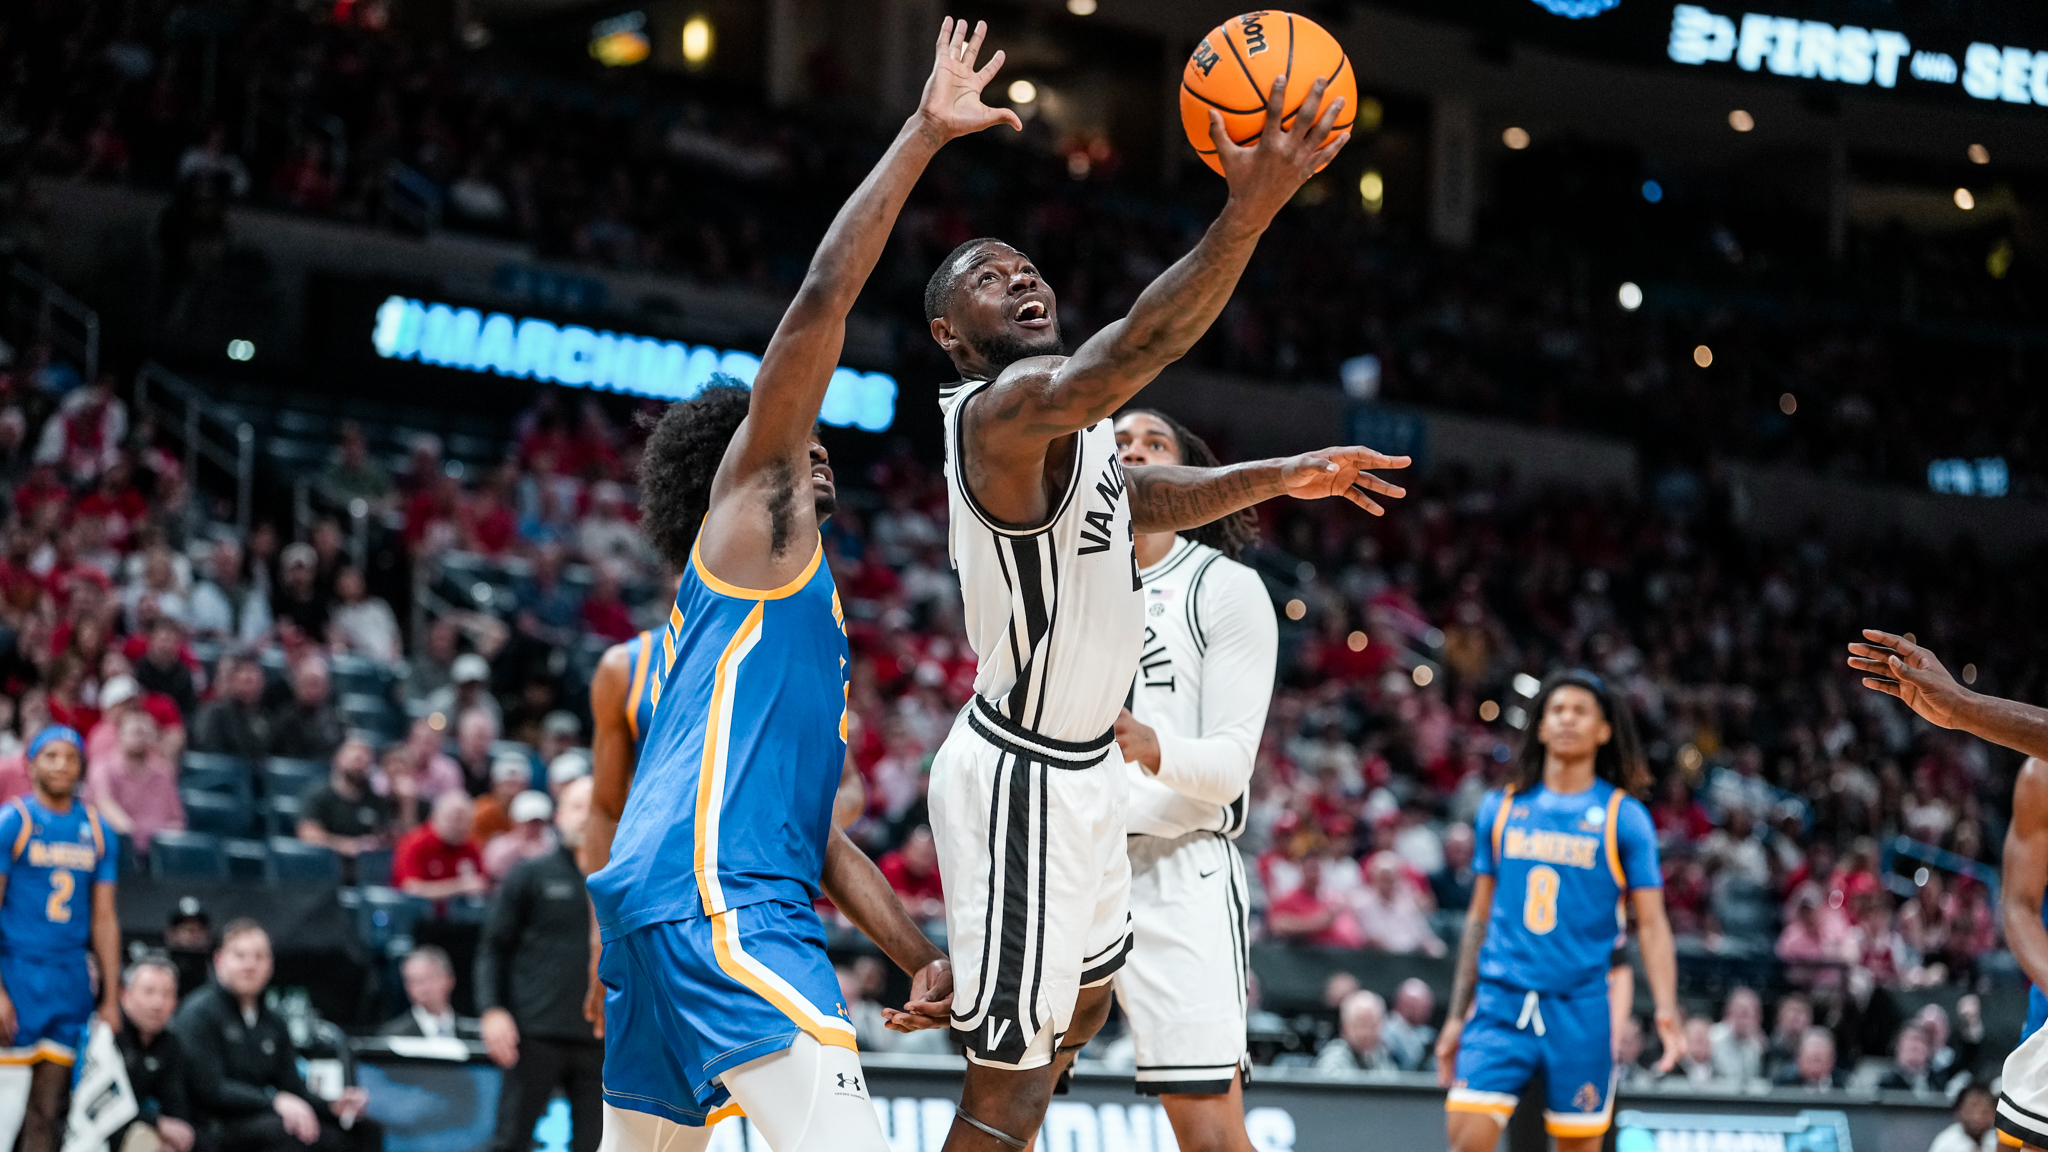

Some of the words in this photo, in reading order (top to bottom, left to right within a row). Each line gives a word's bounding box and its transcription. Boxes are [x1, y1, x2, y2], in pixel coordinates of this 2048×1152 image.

[1736, 12, 1911, 89] FIRST
[46, 867, 75, 924] 2
[1523, 864, 1561, 935] 8
[987, 1015, 1011, 1052] V
